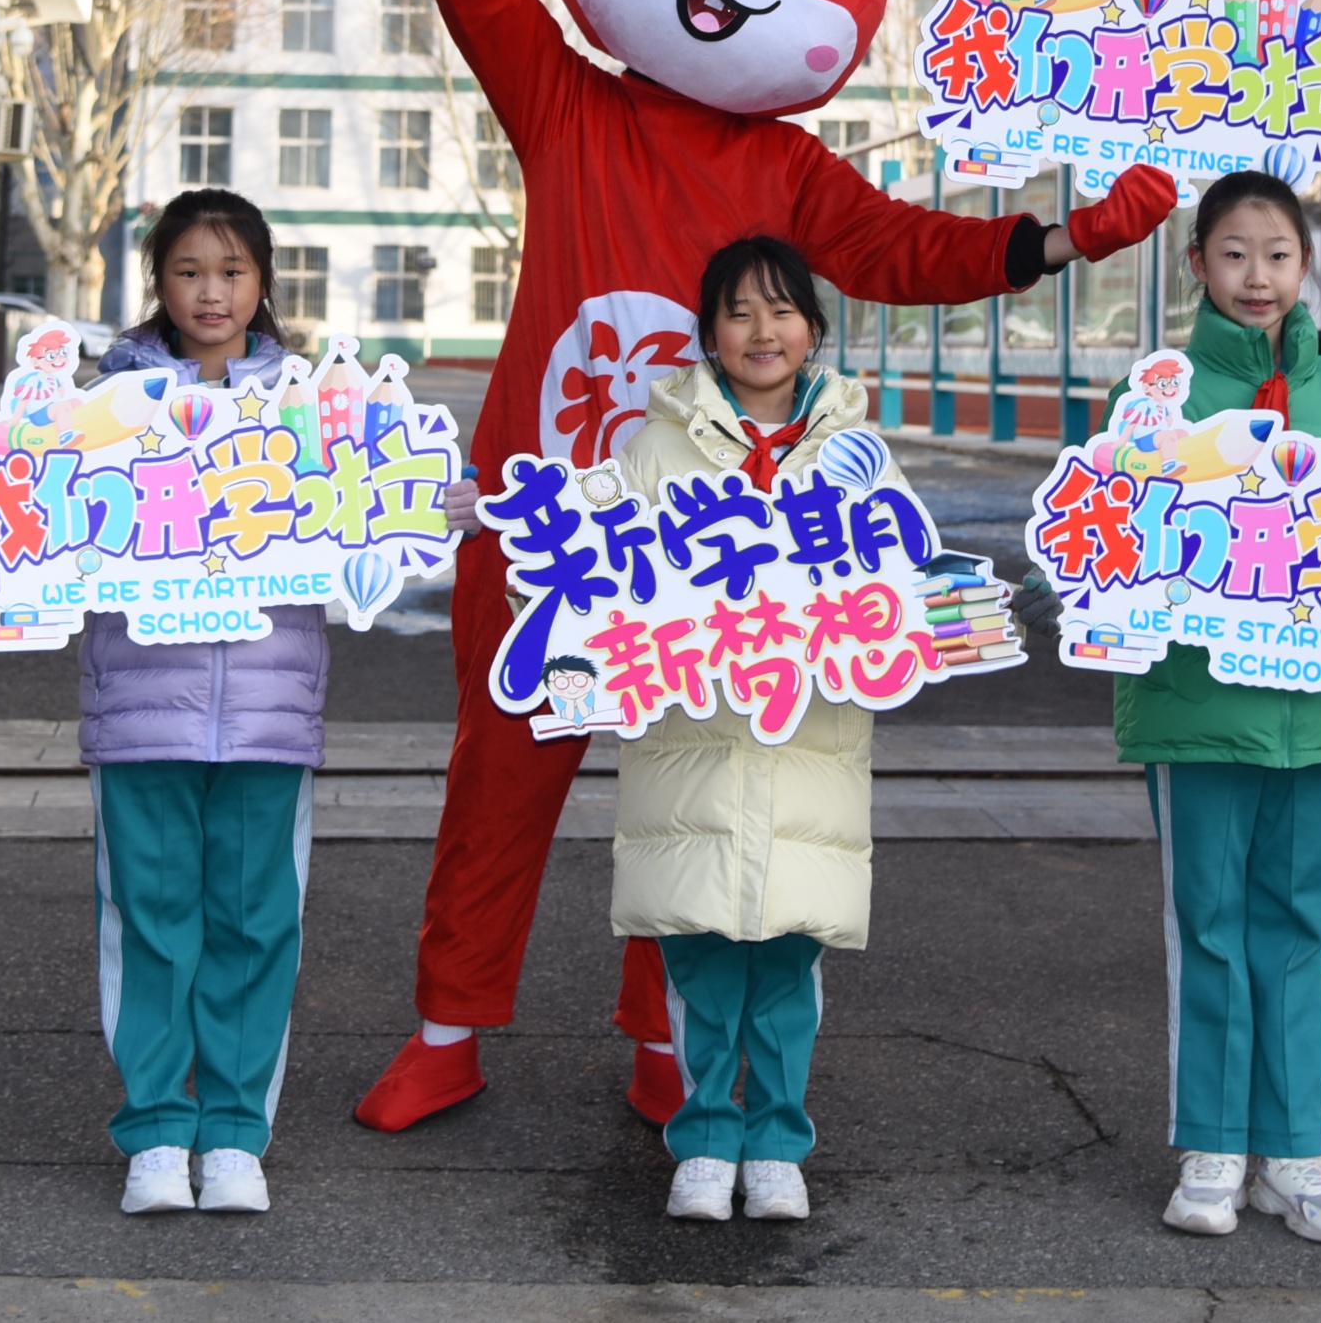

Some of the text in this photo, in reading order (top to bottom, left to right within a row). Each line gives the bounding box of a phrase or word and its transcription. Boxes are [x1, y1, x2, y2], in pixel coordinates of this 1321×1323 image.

[1006, 129, 1253, 176] WE RE STARTINGE
[1084, 168, 1190, 199] SCL
[41, 573, 332, 606] WE RE STARTINGE
[485, 460, 932, 701] 新学期
[137, 610, 263, 635] SCHOOL
[1128, 608, 1172, 633] WE
[1183, 614, 1227, 638] RE
[585, 583, 944, 734] 新梦想
